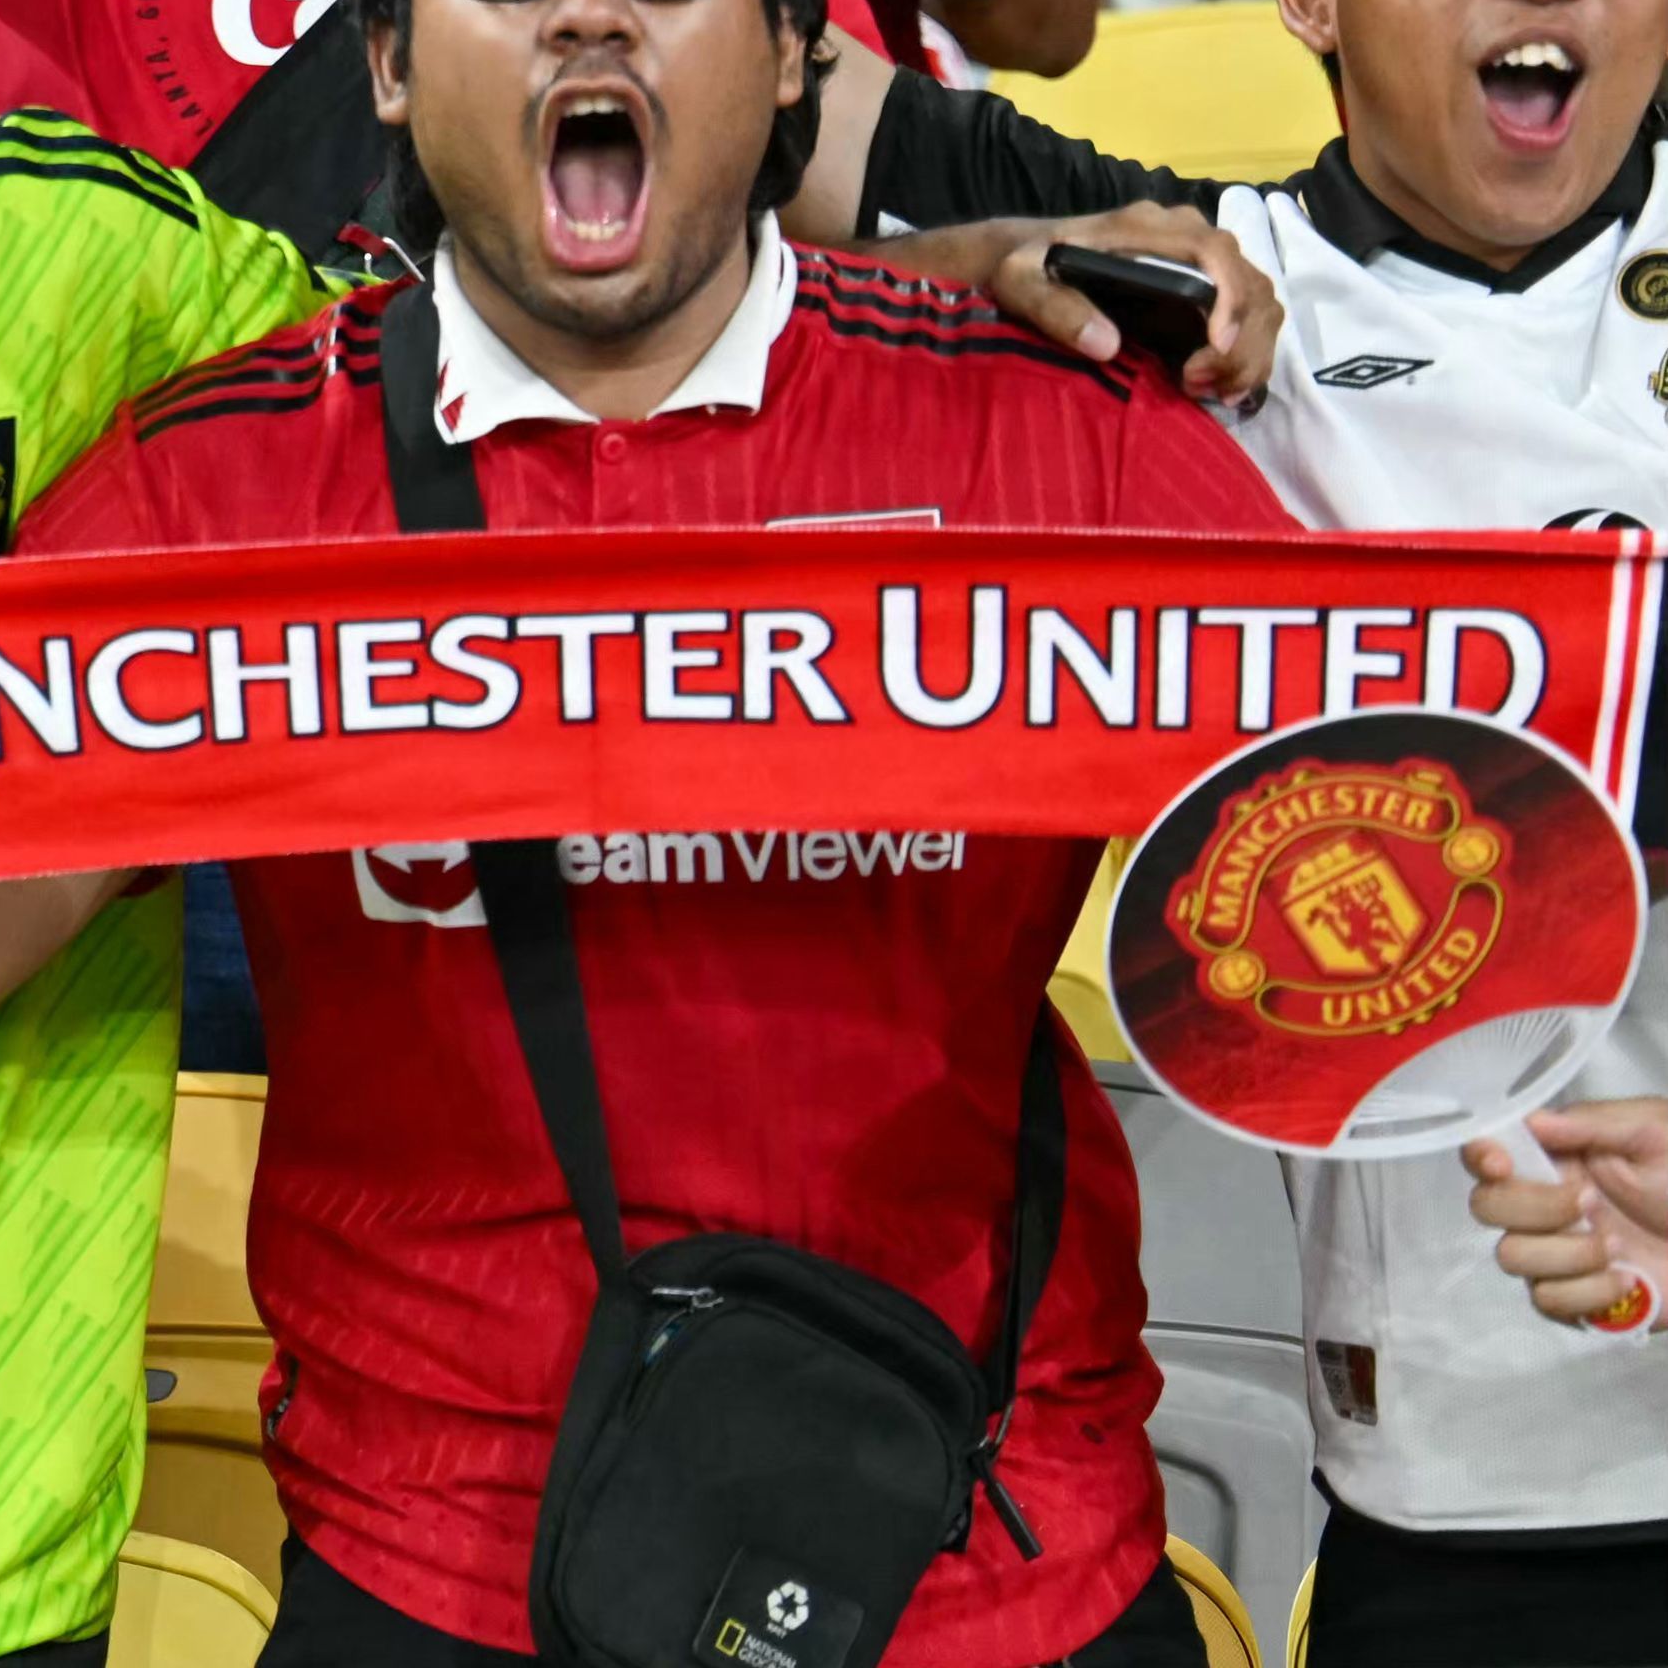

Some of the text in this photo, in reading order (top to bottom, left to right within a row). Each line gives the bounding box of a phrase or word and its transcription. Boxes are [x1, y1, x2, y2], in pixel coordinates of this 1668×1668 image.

[876, 584, 1548, 730] UNITED
[1207, 785, 1436, 929] MANCHESTER
[1321, 927, 1479, 1027] UNITED
